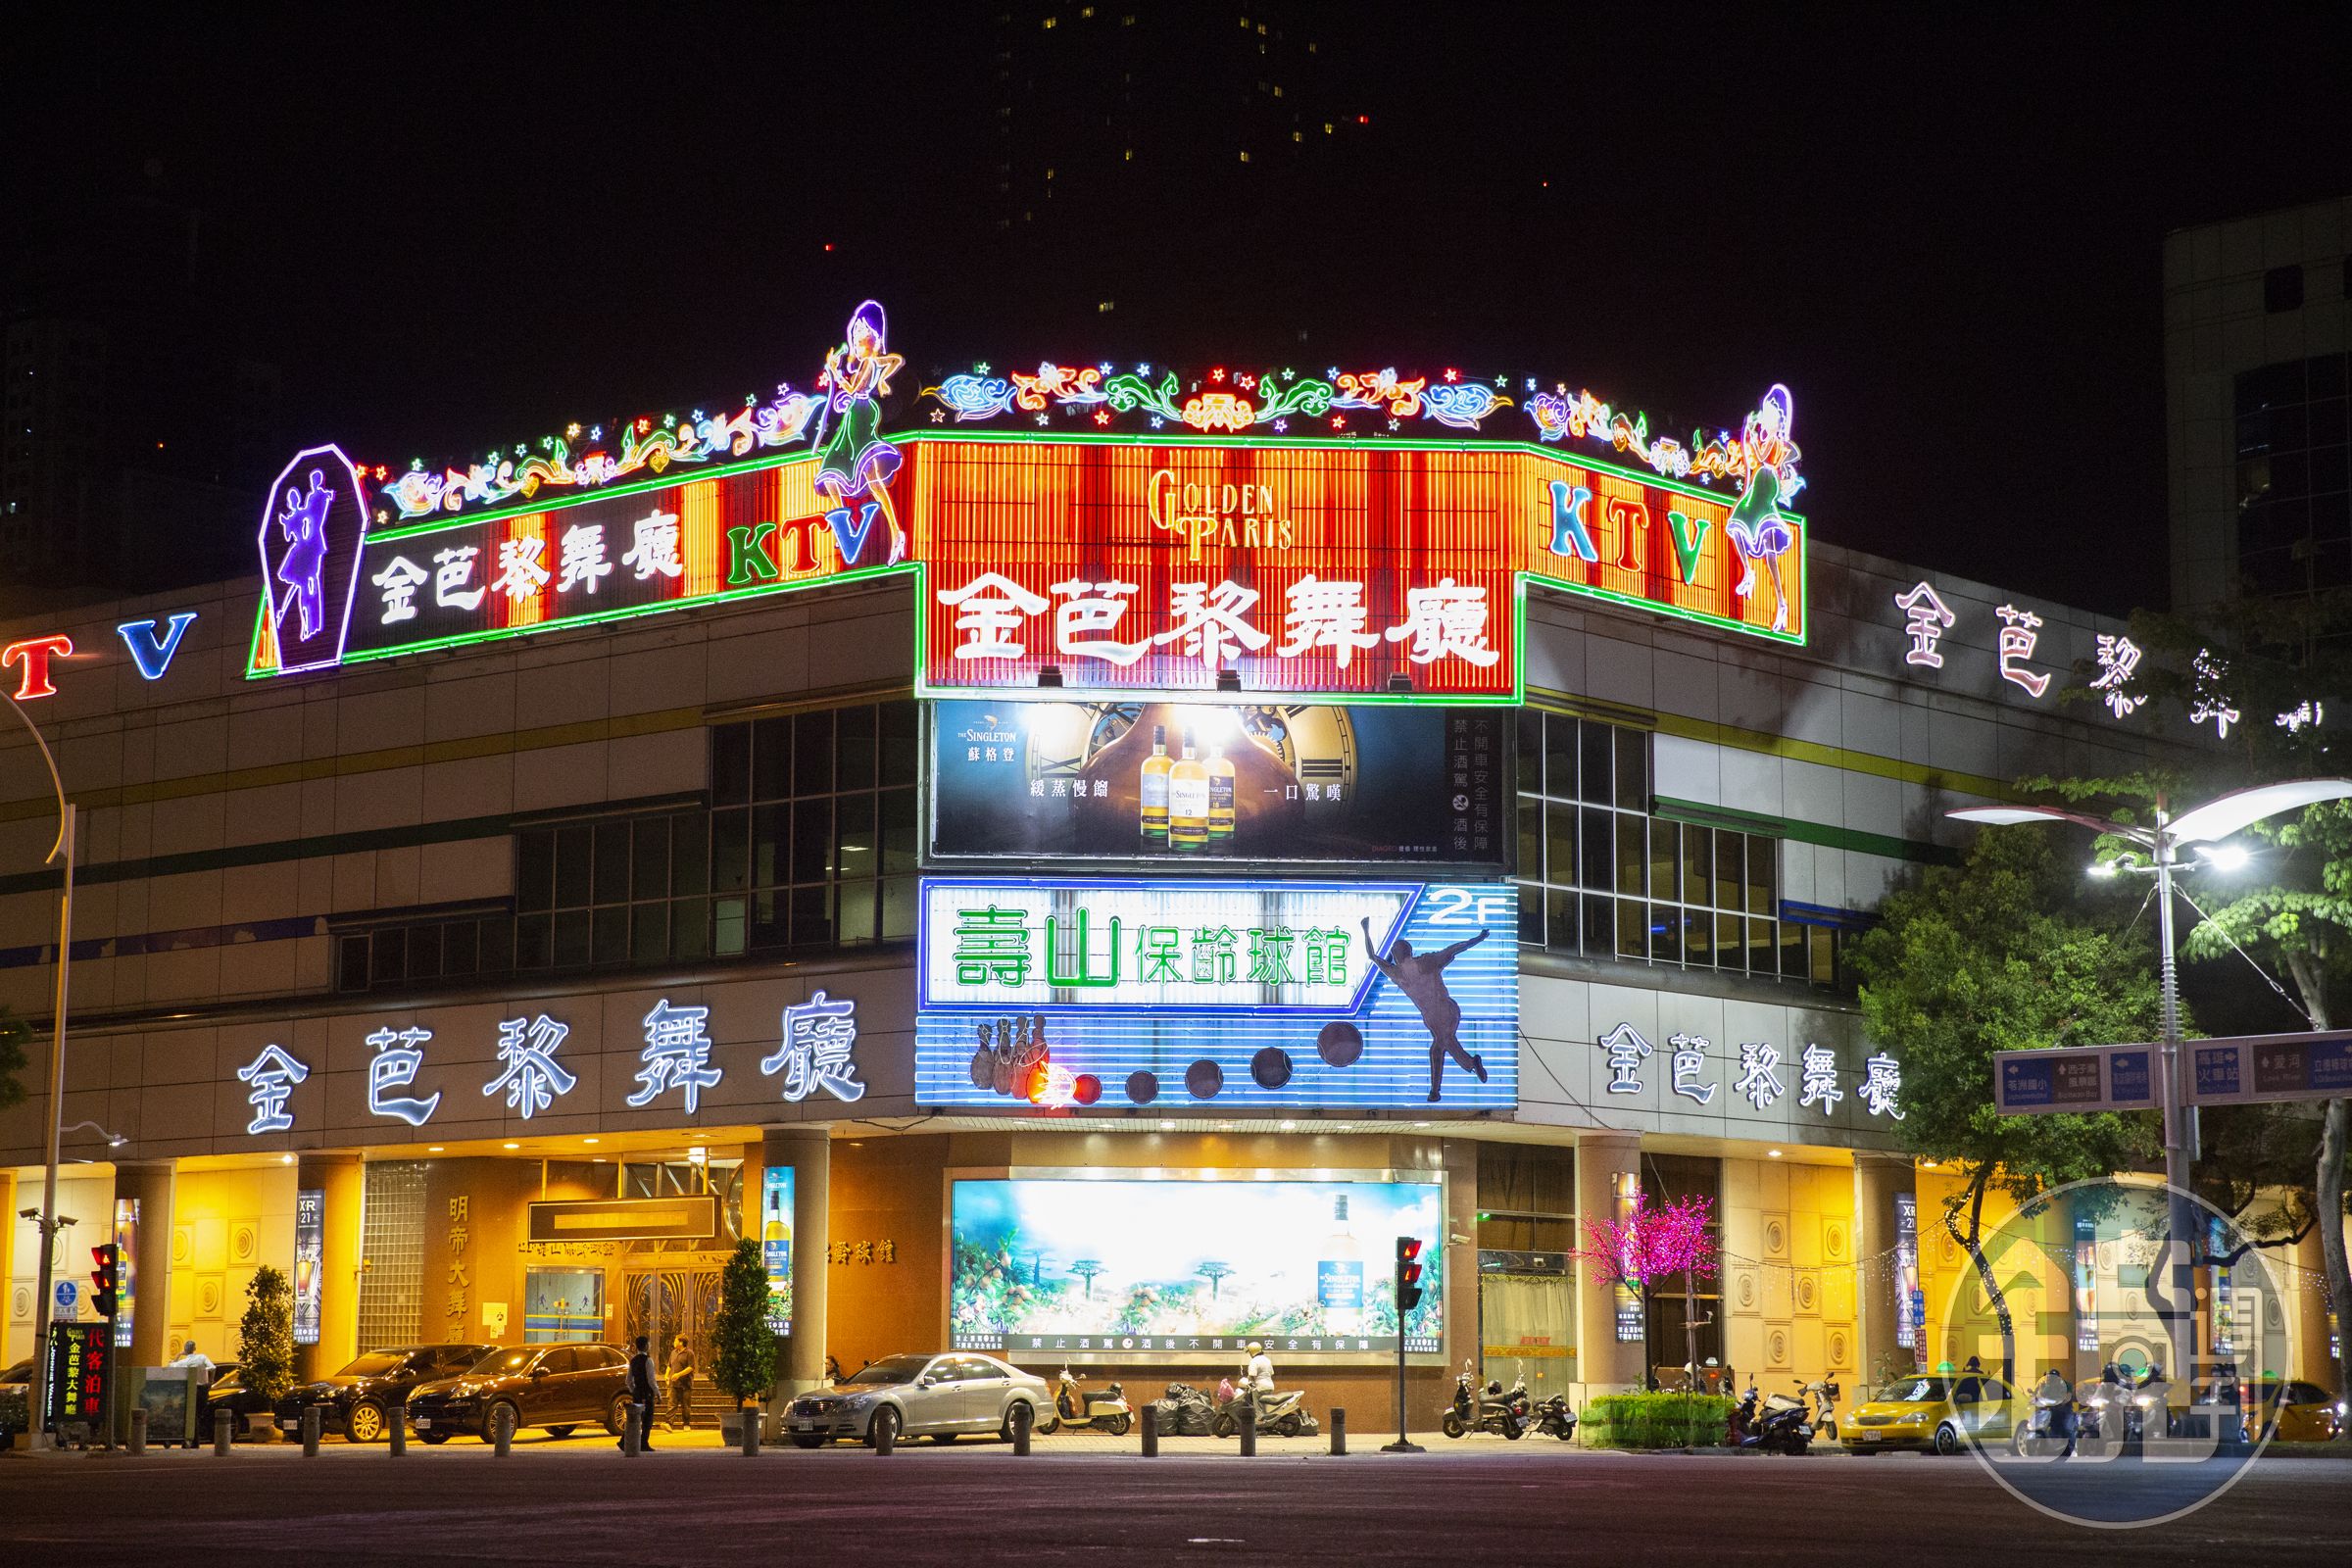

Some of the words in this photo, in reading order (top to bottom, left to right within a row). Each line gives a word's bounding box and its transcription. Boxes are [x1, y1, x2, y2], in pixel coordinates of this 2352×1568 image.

[372, 509, 684, 625] 金芭黎舞廳
[727, 502, 881, 585] KTV
[1549, 480, 1712, 585] KTV
[936, 571, 1500, 670] 金芭黎舞廳
[1894, 580, 2327, 751] 金芭黎
[966, 728, 1016, 743] SINGLETON
[968, 747, 1014, 761] 蘇格登
[1453, 719, 1468, 787] 禁止酒駕
[1030, 779, 1108, 798] 緩蒸慢餾
[1263, 783, 1342, 802] 一口驚嘆
[953, 904, 1352, 990] 壽山保齡球館
[1427, 888, 1508, 925] 2F
[237, 990, 865, 1135] 金芭黎舞廳
[1598, 1021, 1906, 1120] 金芭黎舞廳
[65, 1343, 80, 1416] 金芭黎大舞廳
[84, 1329, 105, 1417] 代客泊車
[1032, 1337, 1113, 1349] 禁止酒駕
